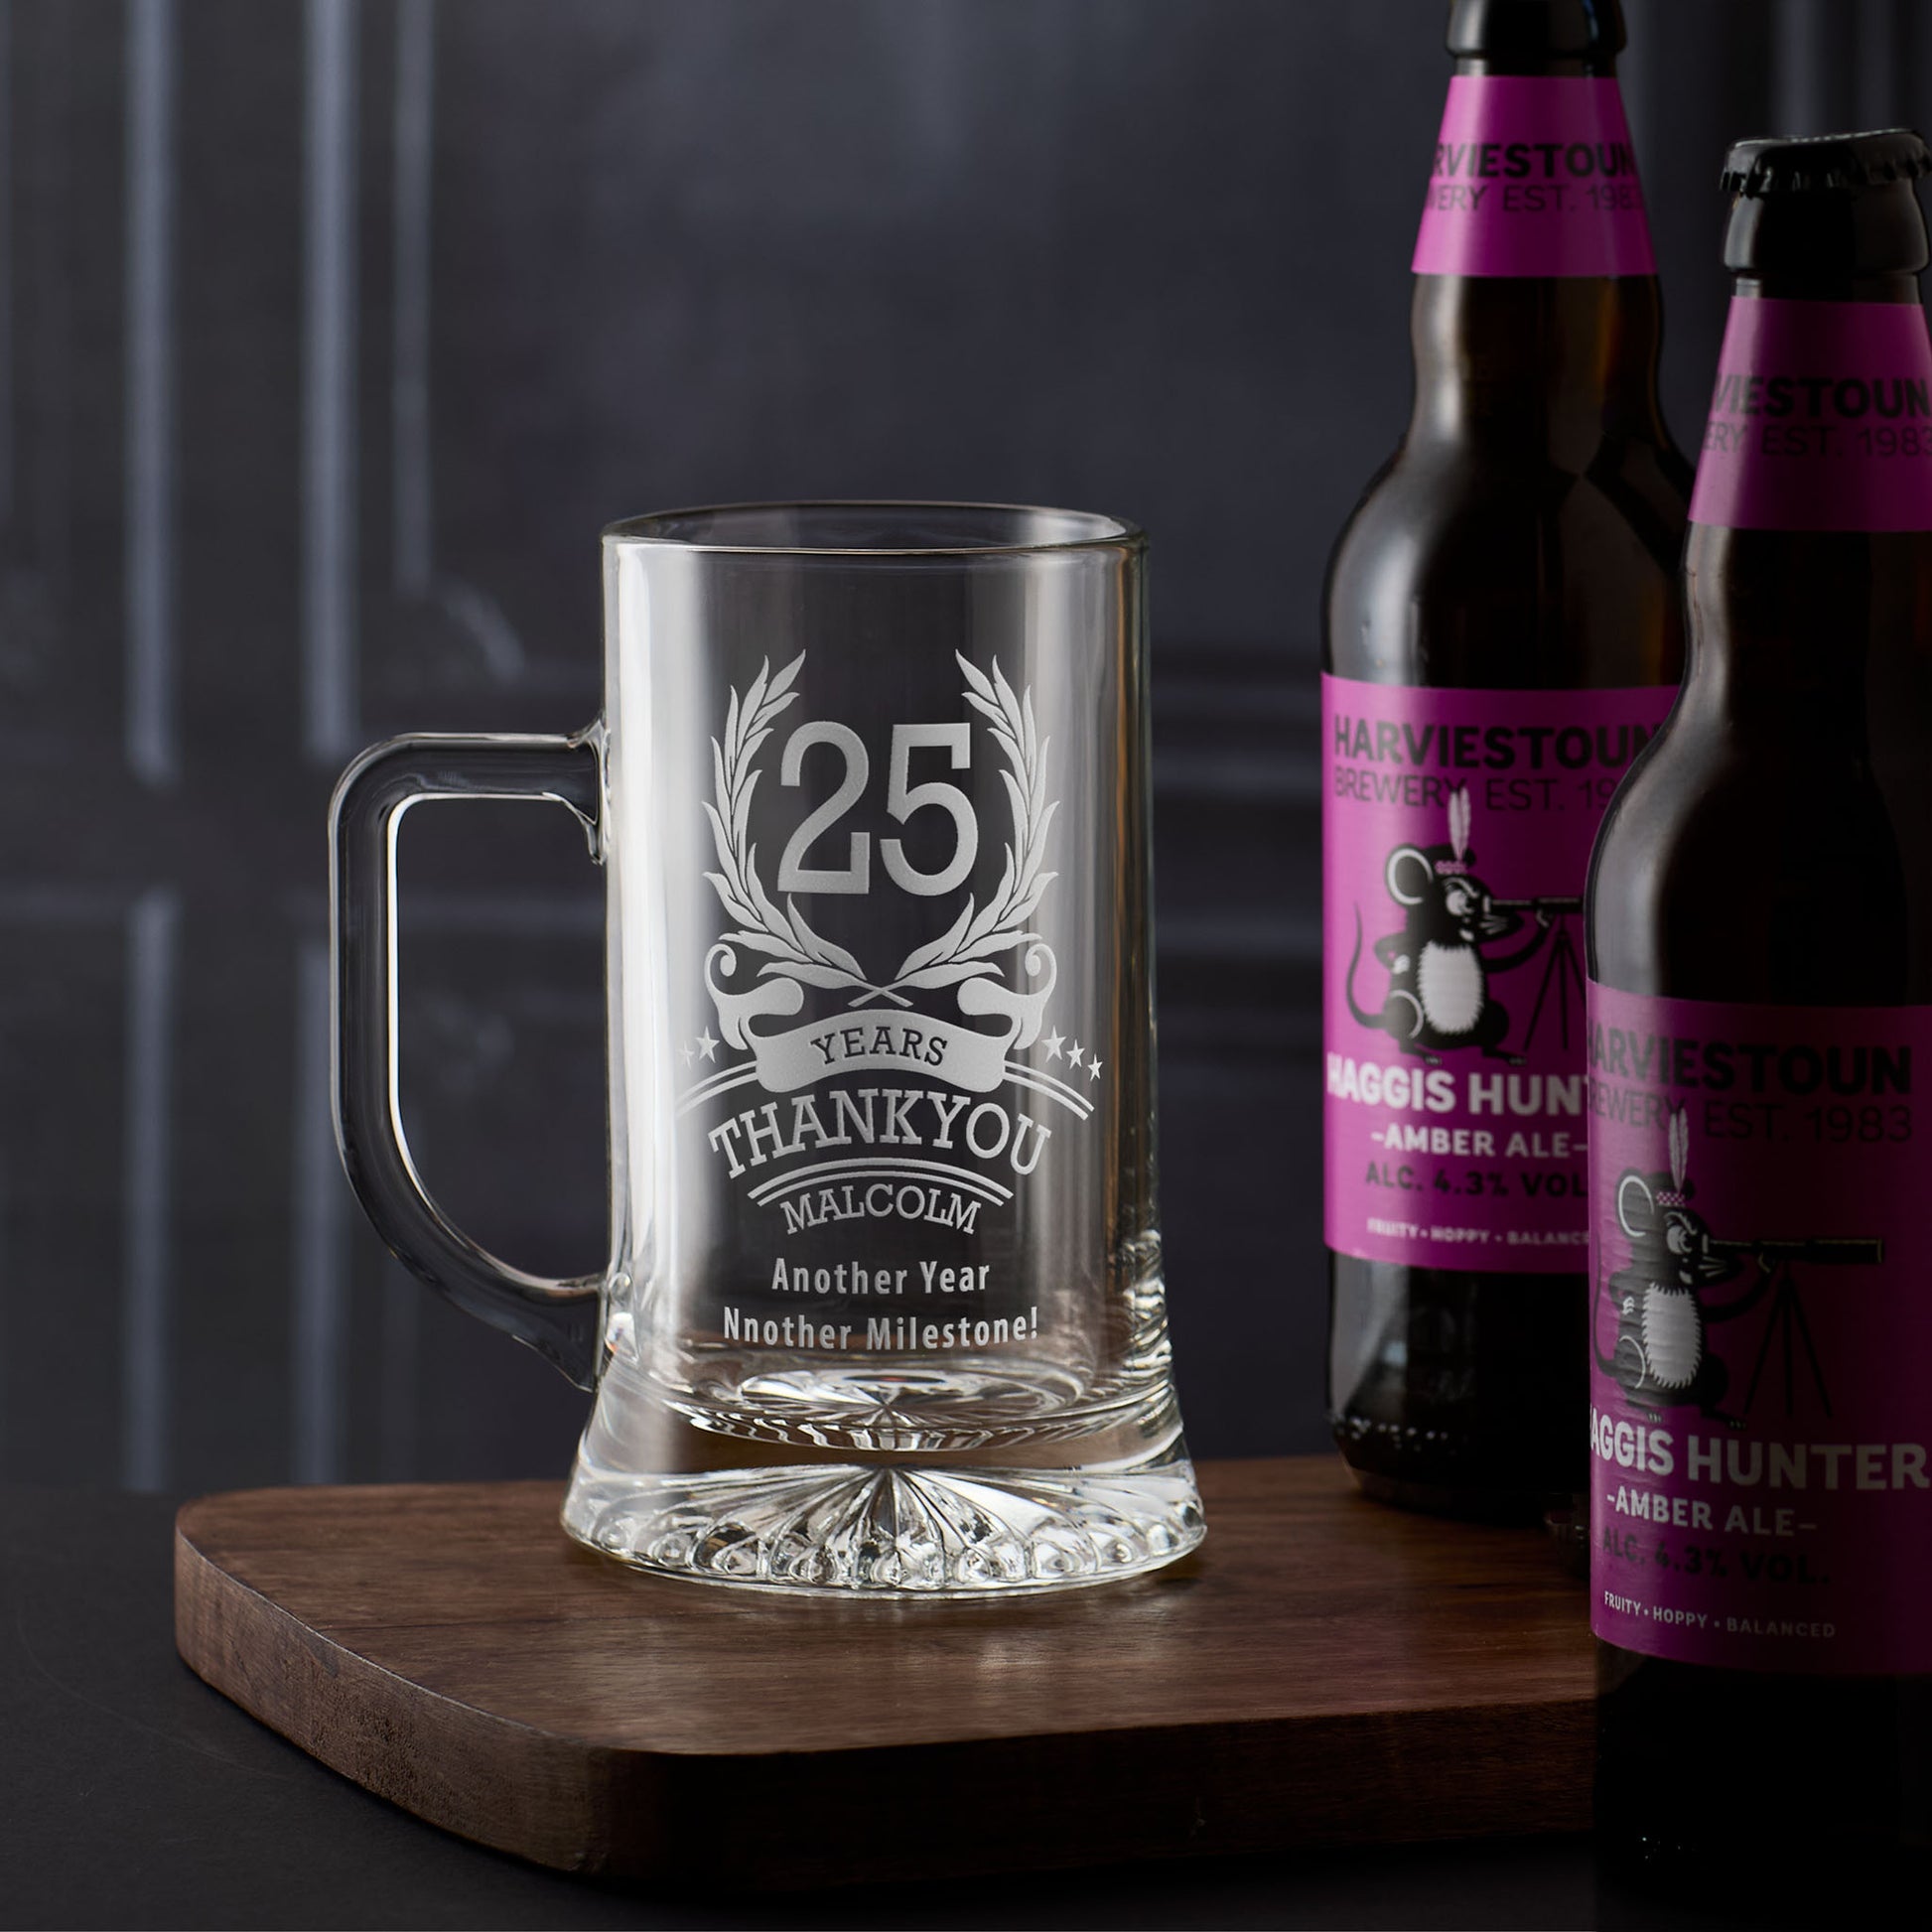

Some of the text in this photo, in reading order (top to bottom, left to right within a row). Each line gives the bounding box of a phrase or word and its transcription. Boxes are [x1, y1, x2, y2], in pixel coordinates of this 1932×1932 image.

[777, 721, 979, 897] 25
[1485, 777, 1566, 812] EST.
[810, 1026, 948, 1066] YEARS
[1326, 1050, 1588, 1118] HAGGIS HUN
[707, 1088, 1052, 1179] THANKYOU
[1704, 1099, 1793, 1143] EST.
[1807, 1103, 1912, 1143] 1983
[1366, 1160, 1423, 1190] ALC.
[1434, 1169, 1509, 1196] 4.3%
[779, 1183, 982, 1235] MALCOLM
[1430, 1225, 1491, 1245] HOPPY
[771, 1257, 990, 1295] Another Year
[723, 1306, 1037, 1350] Nnother Milestone!
[1687, 1435, 1931, 1491] HUNTER
[1654, 1540, 1728, 1578] 4.3%
[1739, 1550, 1831, 1585] VOL.
[1603, 1590, 1837, 1639] FRUITY HOPPY BALANCED
